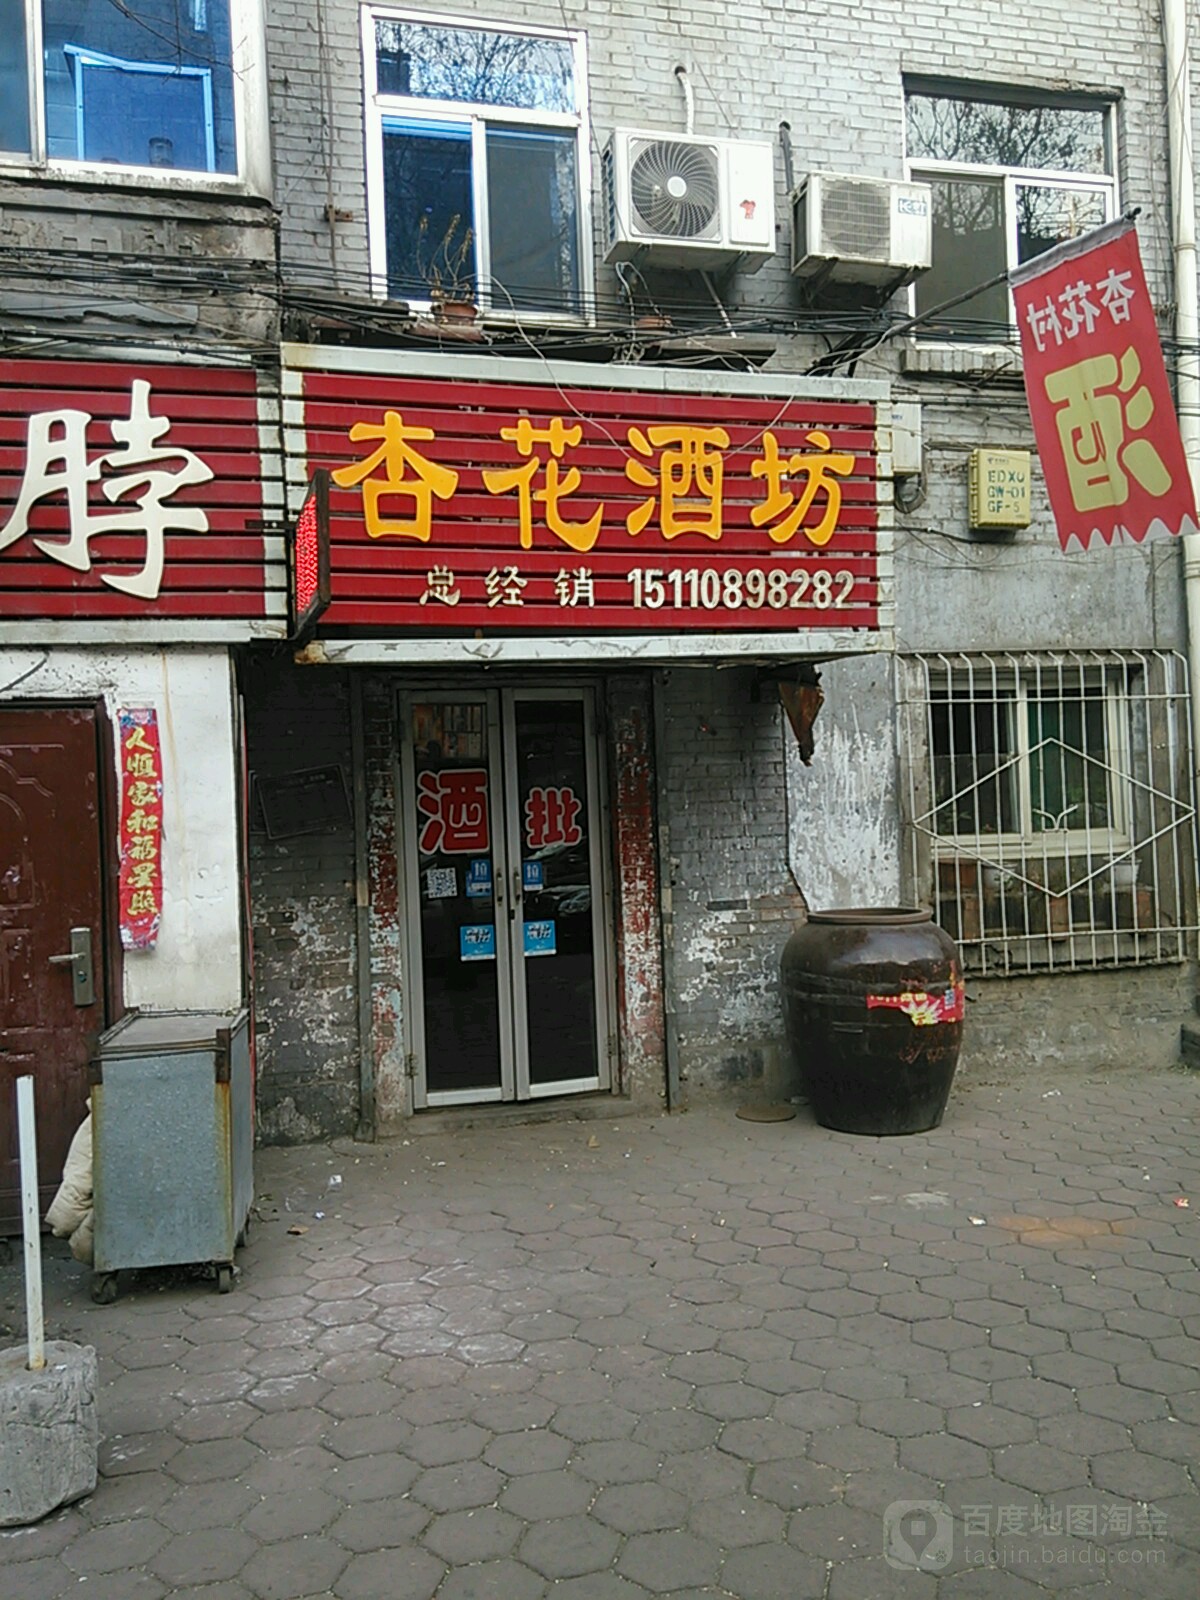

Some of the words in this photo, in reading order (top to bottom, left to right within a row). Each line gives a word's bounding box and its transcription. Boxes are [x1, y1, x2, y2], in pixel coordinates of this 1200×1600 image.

[0, 378, 215, 600] 脖
[331, 410, 856, 552] 杏花酒坊
[419, 564, 595, 608] 总经销
[626, 568, 855, 609] 15110898282
[418, 769, 489, 854] 酒
[525, 787, 581, 848] 批
